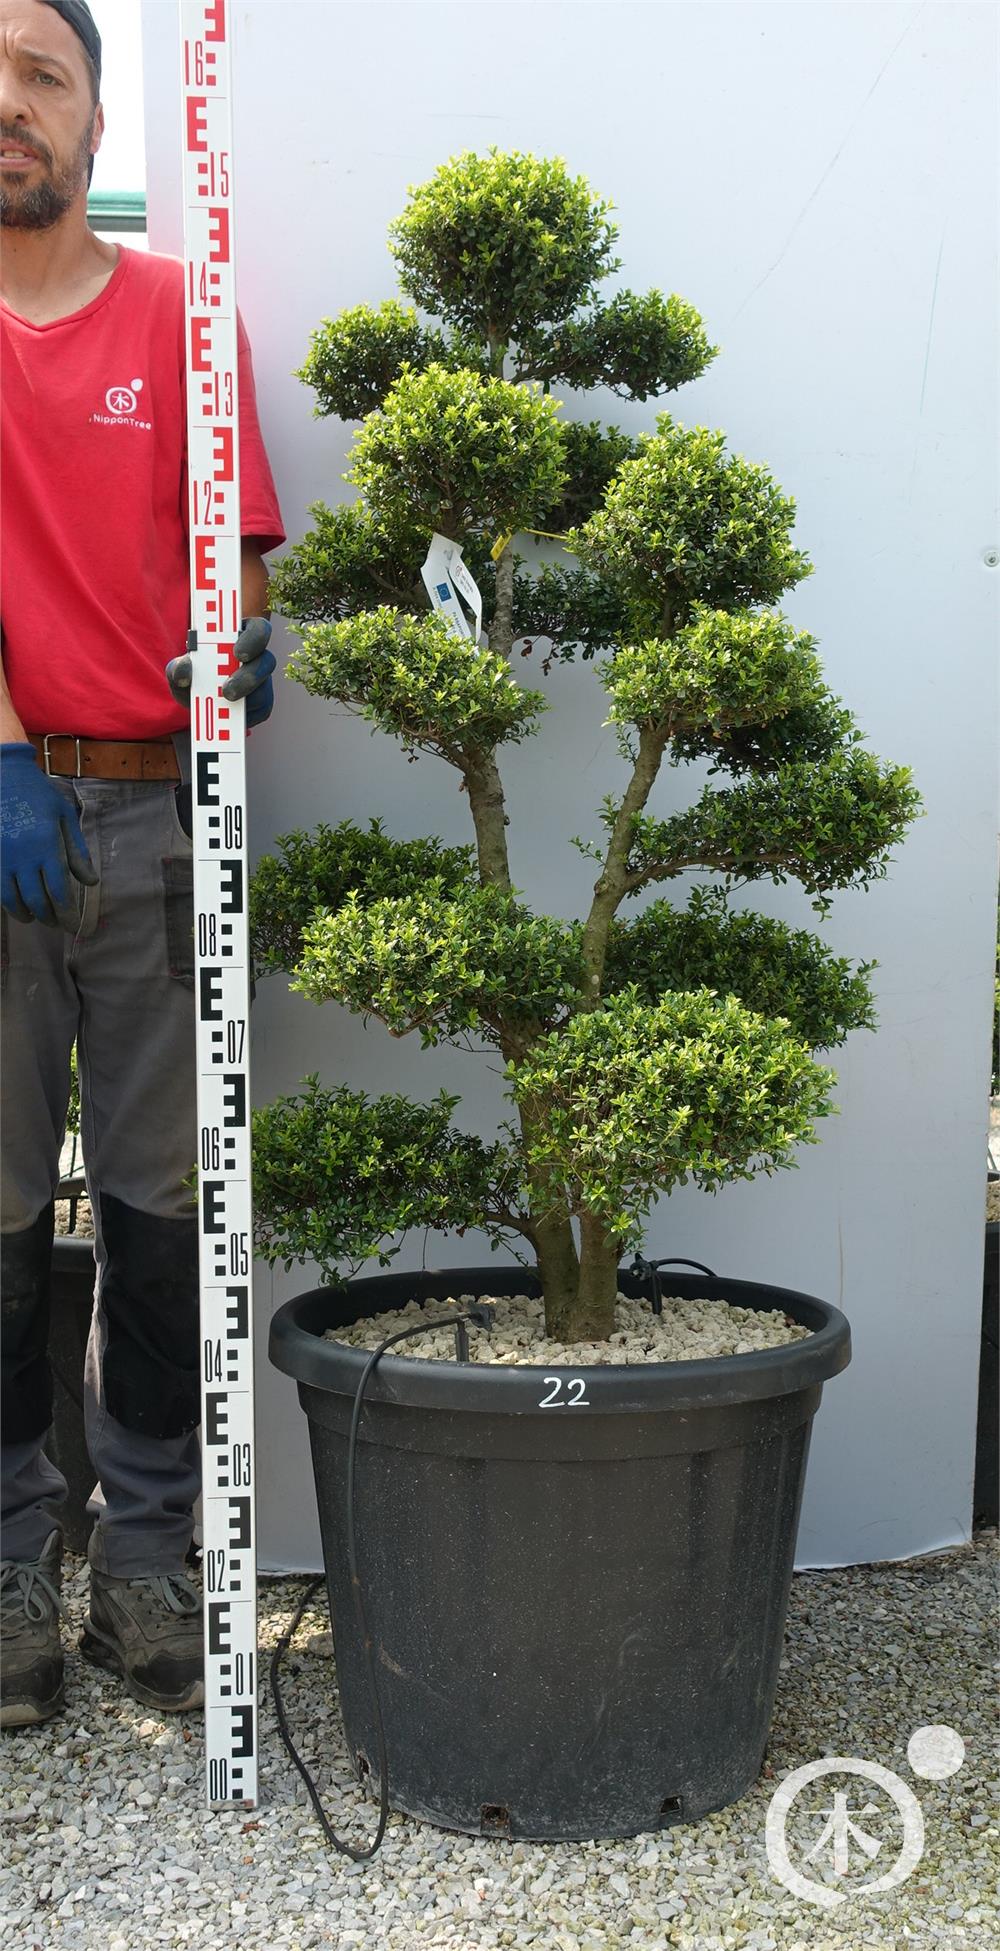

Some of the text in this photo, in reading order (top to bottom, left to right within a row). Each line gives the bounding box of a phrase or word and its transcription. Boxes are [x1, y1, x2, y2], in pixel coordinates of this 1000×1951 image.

[184, 39, 204, 86] 16
[210, 151, 229, 198] 15
[189, 260, 208, 307] 14
[214, 371, 233, 416] 13
[93, 413, 152, 430] NipponTree
[193, 480, 212, 525] 12
[218, 589, 237, 632] 11
[195, 696, 214, 741] 10
[224, 805, 243, 849] 09
[198, 913, 217, 957] 08
[227, 1019, 246, 1063] 07
[201, 1126, 220, 1171] 06
[230, 1232, 248, 1276] 05
[204, 1339, 222, 1383] 04
[538, 1376, 590, 1408] 22
[233, 1443, 251, 1487] 03
[207, 1549, 226, 1593] 02
[235, 1651, 254, 1695] 01
[209, 1758, 228, 1800] 00
